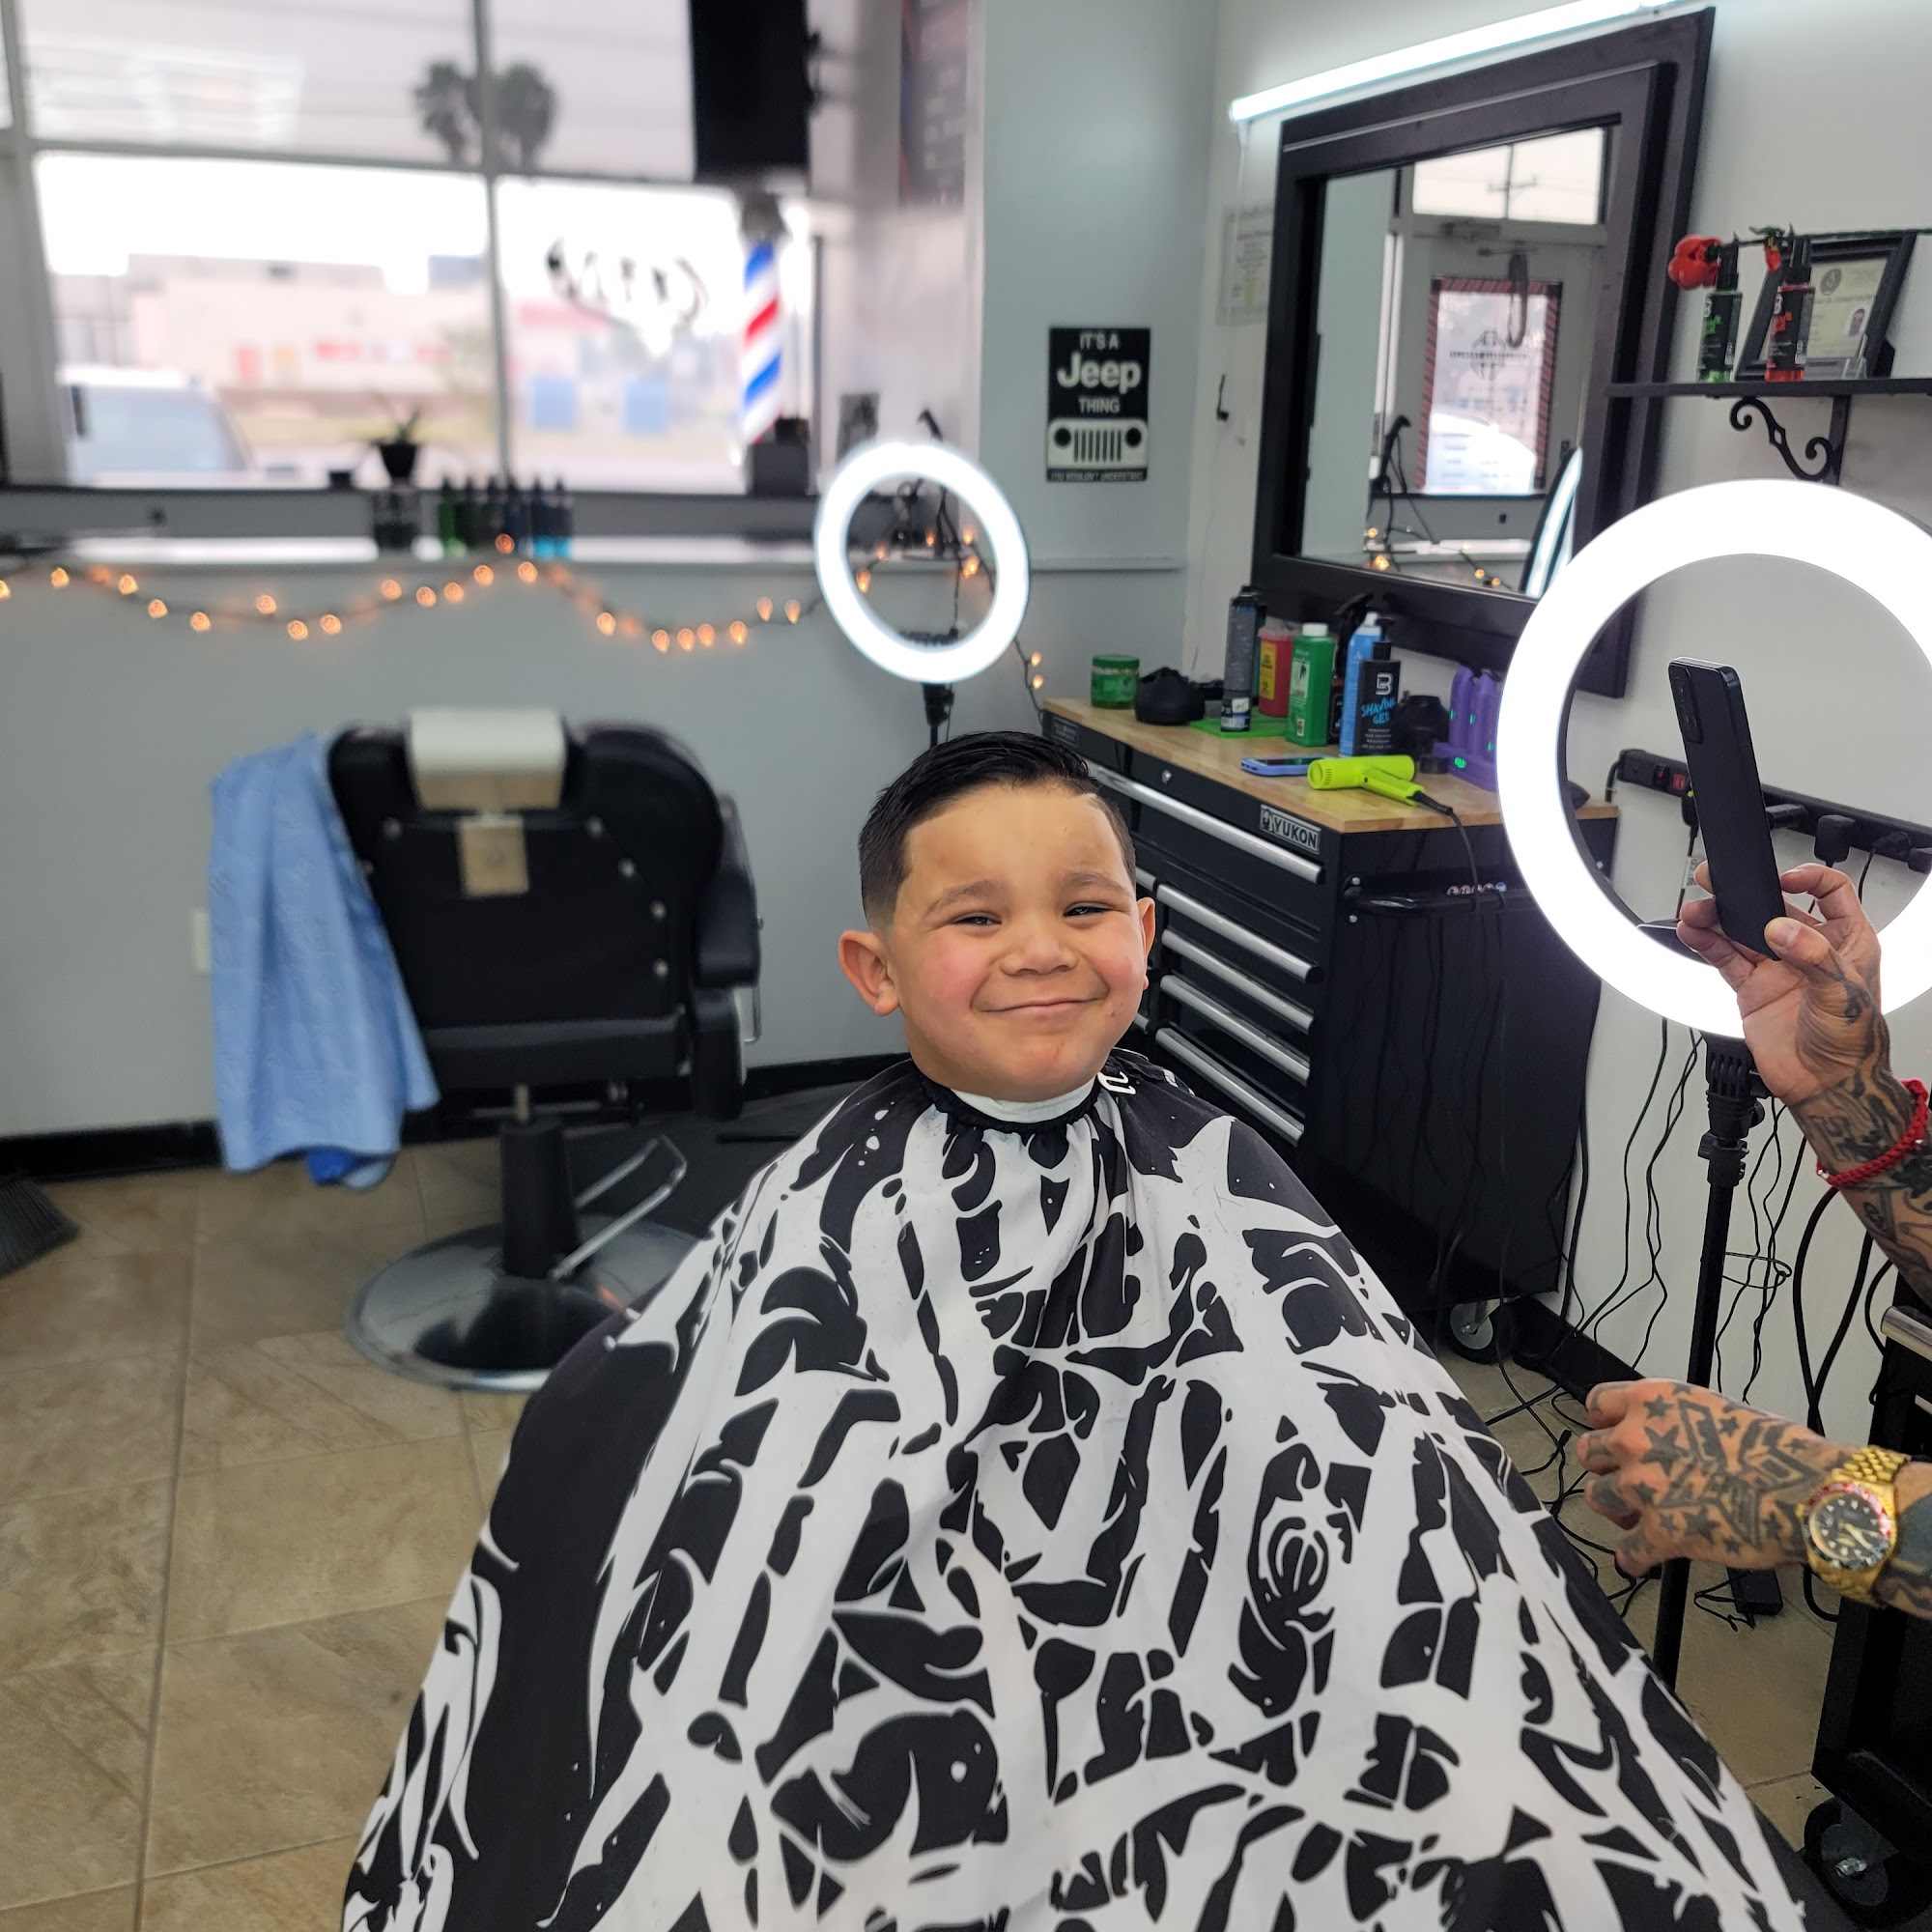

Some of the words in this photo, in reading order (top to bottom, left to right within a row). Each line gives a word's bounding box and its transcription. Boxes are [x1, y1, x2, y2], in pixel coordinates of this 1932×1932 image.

[1109, 333, 1120, 350] A
[1057, 351, 1142, 395] Jeep
[1078, 397, 1121, 413] THING
[1372, 711, 1390, 724] GEL
[1273, 817, 1317, 849] YUKON
